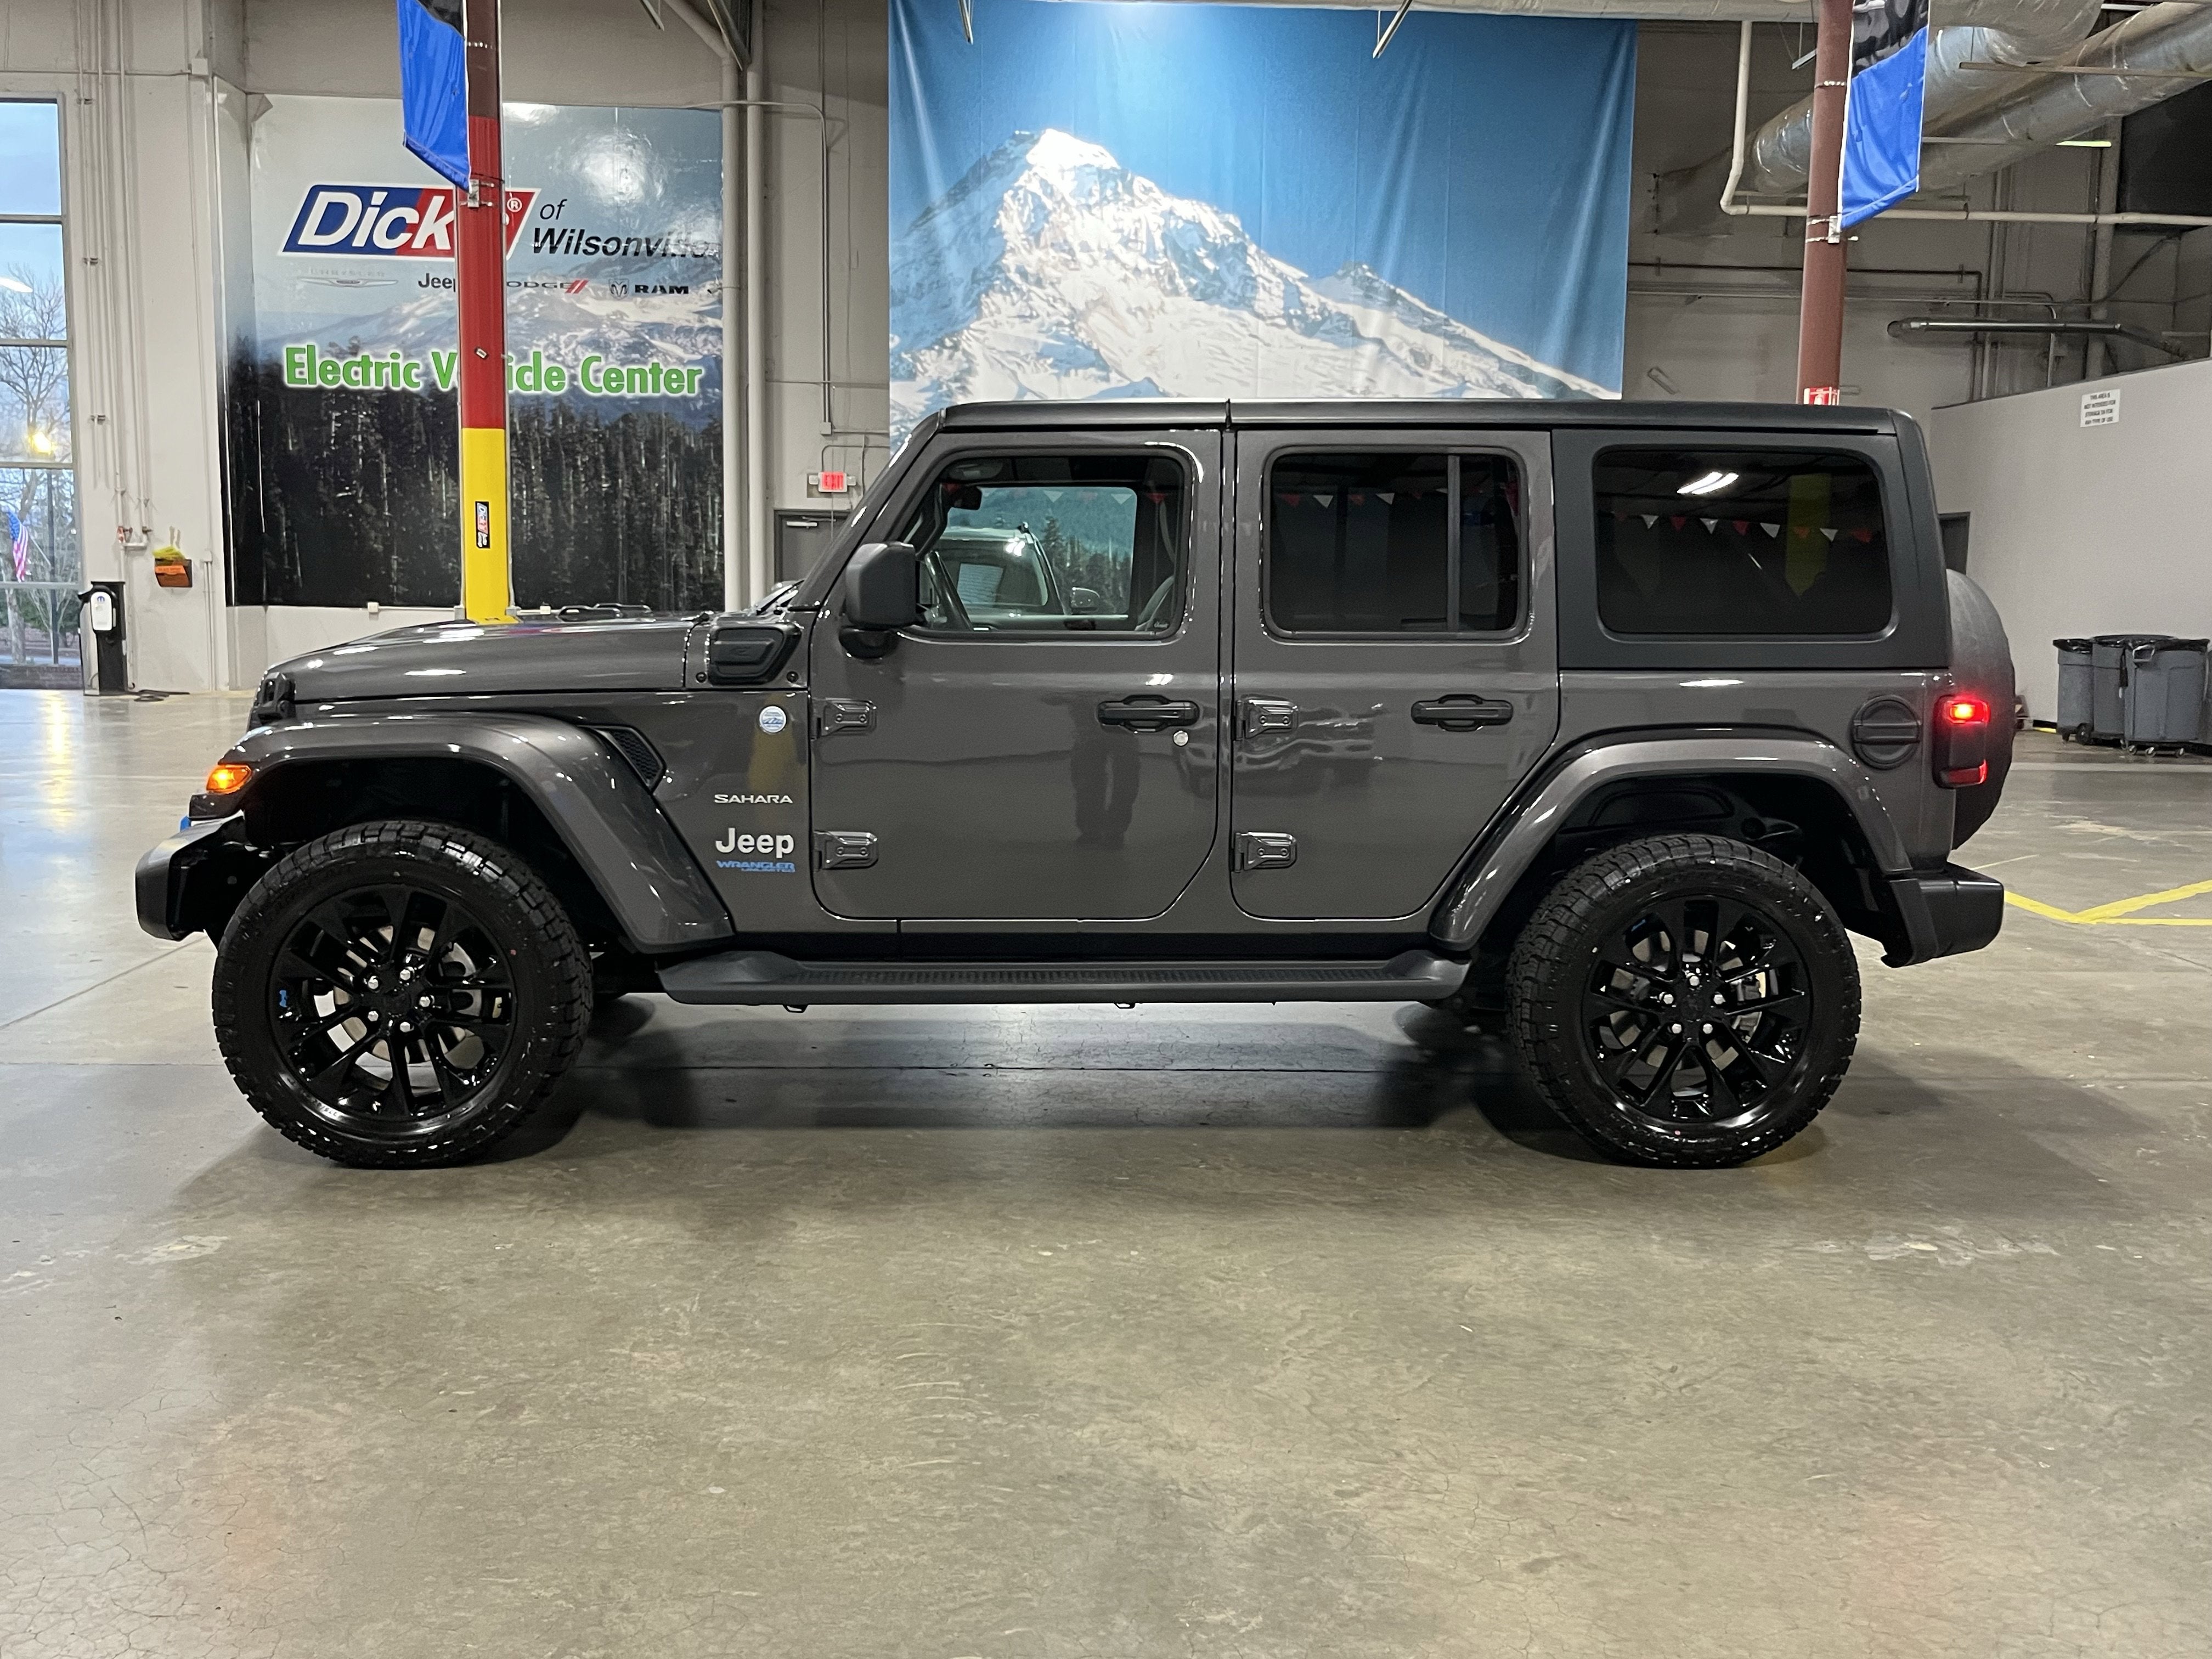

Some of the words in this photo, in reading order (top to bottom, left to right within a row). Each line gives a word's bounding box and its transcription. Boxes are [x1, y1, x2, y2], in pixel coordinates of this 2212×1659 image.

[540, 199, 567, 220] of
[506, 280, 574, 289] ODGE
[635, 284, 689, 295] RAM
[286, 345, 421, 388] Electric
[431, 351, 566, 392] Vicle
[581, 356, 703, 394] Center
[714, 794, 793, 804] SAHARA
[715, 827, 794, 859] Jeep
[716, 860, 795, 871] WRANGLER
